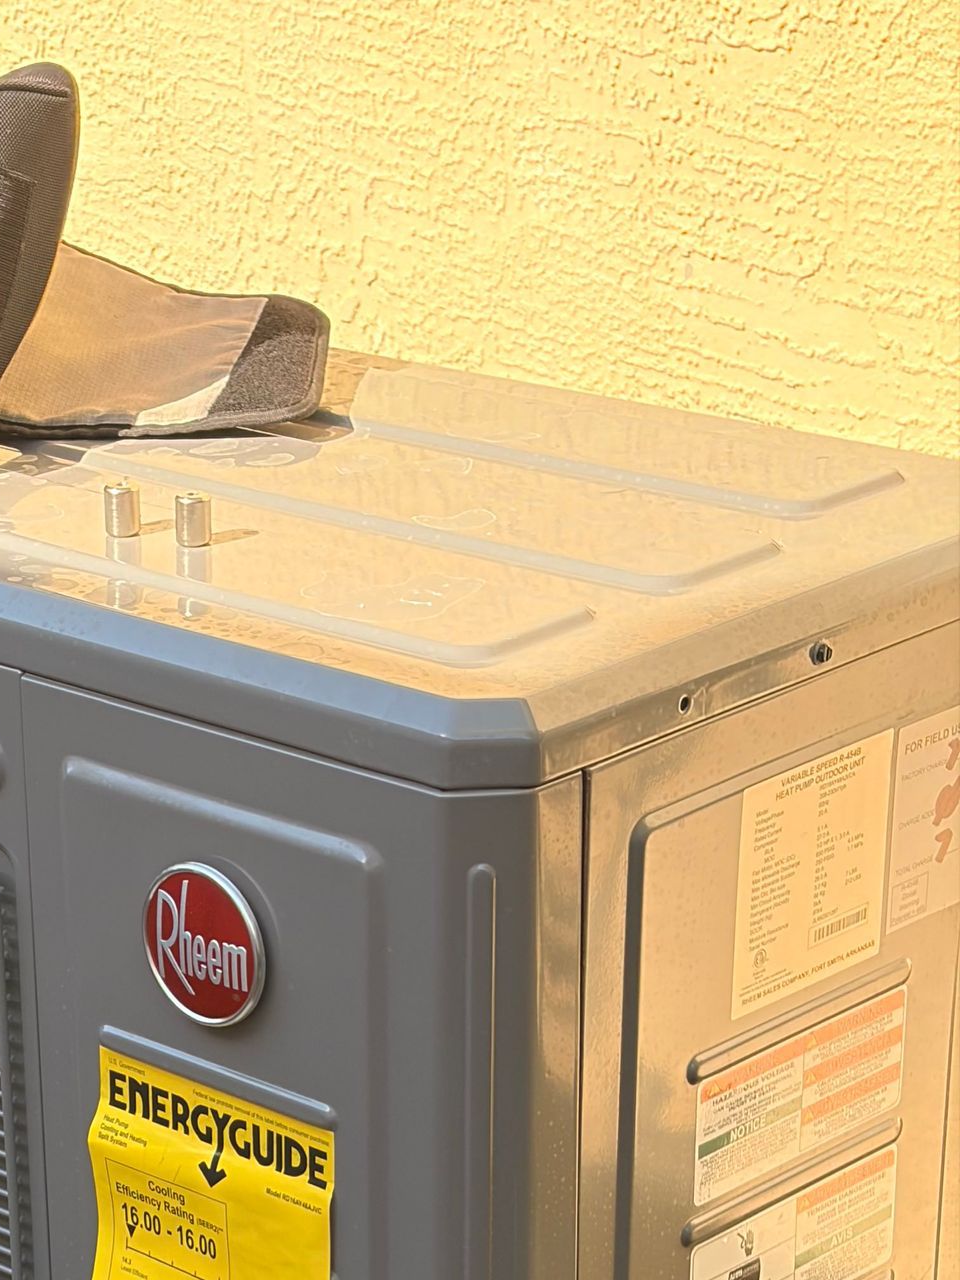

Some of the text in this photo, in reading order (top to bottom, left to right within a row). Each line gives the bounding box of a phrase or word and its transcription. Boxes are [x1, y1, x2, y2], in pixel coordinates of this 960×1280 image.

[904, 728, 950, 755] FOR FIELD
[775, 788, 793, 802] HEAT
[794, 778, 815, 793] PUMP
[815, 763, 849, 785] OUTDOOR
[849, 755, 866, 770] UNIT
[781, 766, 815, 787] VARIABLE
[815, 757, 838, 773] SPEED
[156, 879, 249, 997] Rheem
[762, 983, 781, 997] SALES
[811, 961, 826, 975] FORT
[845, 939, 876, 958] ARKANSAS
[761, 1061, 795, 1081] VOLTAGE
[100, 1122, 147, 1148] Cooling and Heating
[104, 1113, 129, 1130] Heat Pump
[109, 1069, 328, 1190] ENERGYGUIDE
[730, 1113, 767, 1142] NOTICE
[98, 1131, 127, 1148] Split System
[115, 1181, 161, 1211] Efficiency
[164, 1201, 194, 1225] Rating
[148, 1180, 185, 1206] Cooling
[266, 1187, 281, 1199] Model
[122, 1202, 161, 1236] 16.00
[177, 1225, 217, 1260] 16.00
[831, 1226, 854, 1248] AVIS
